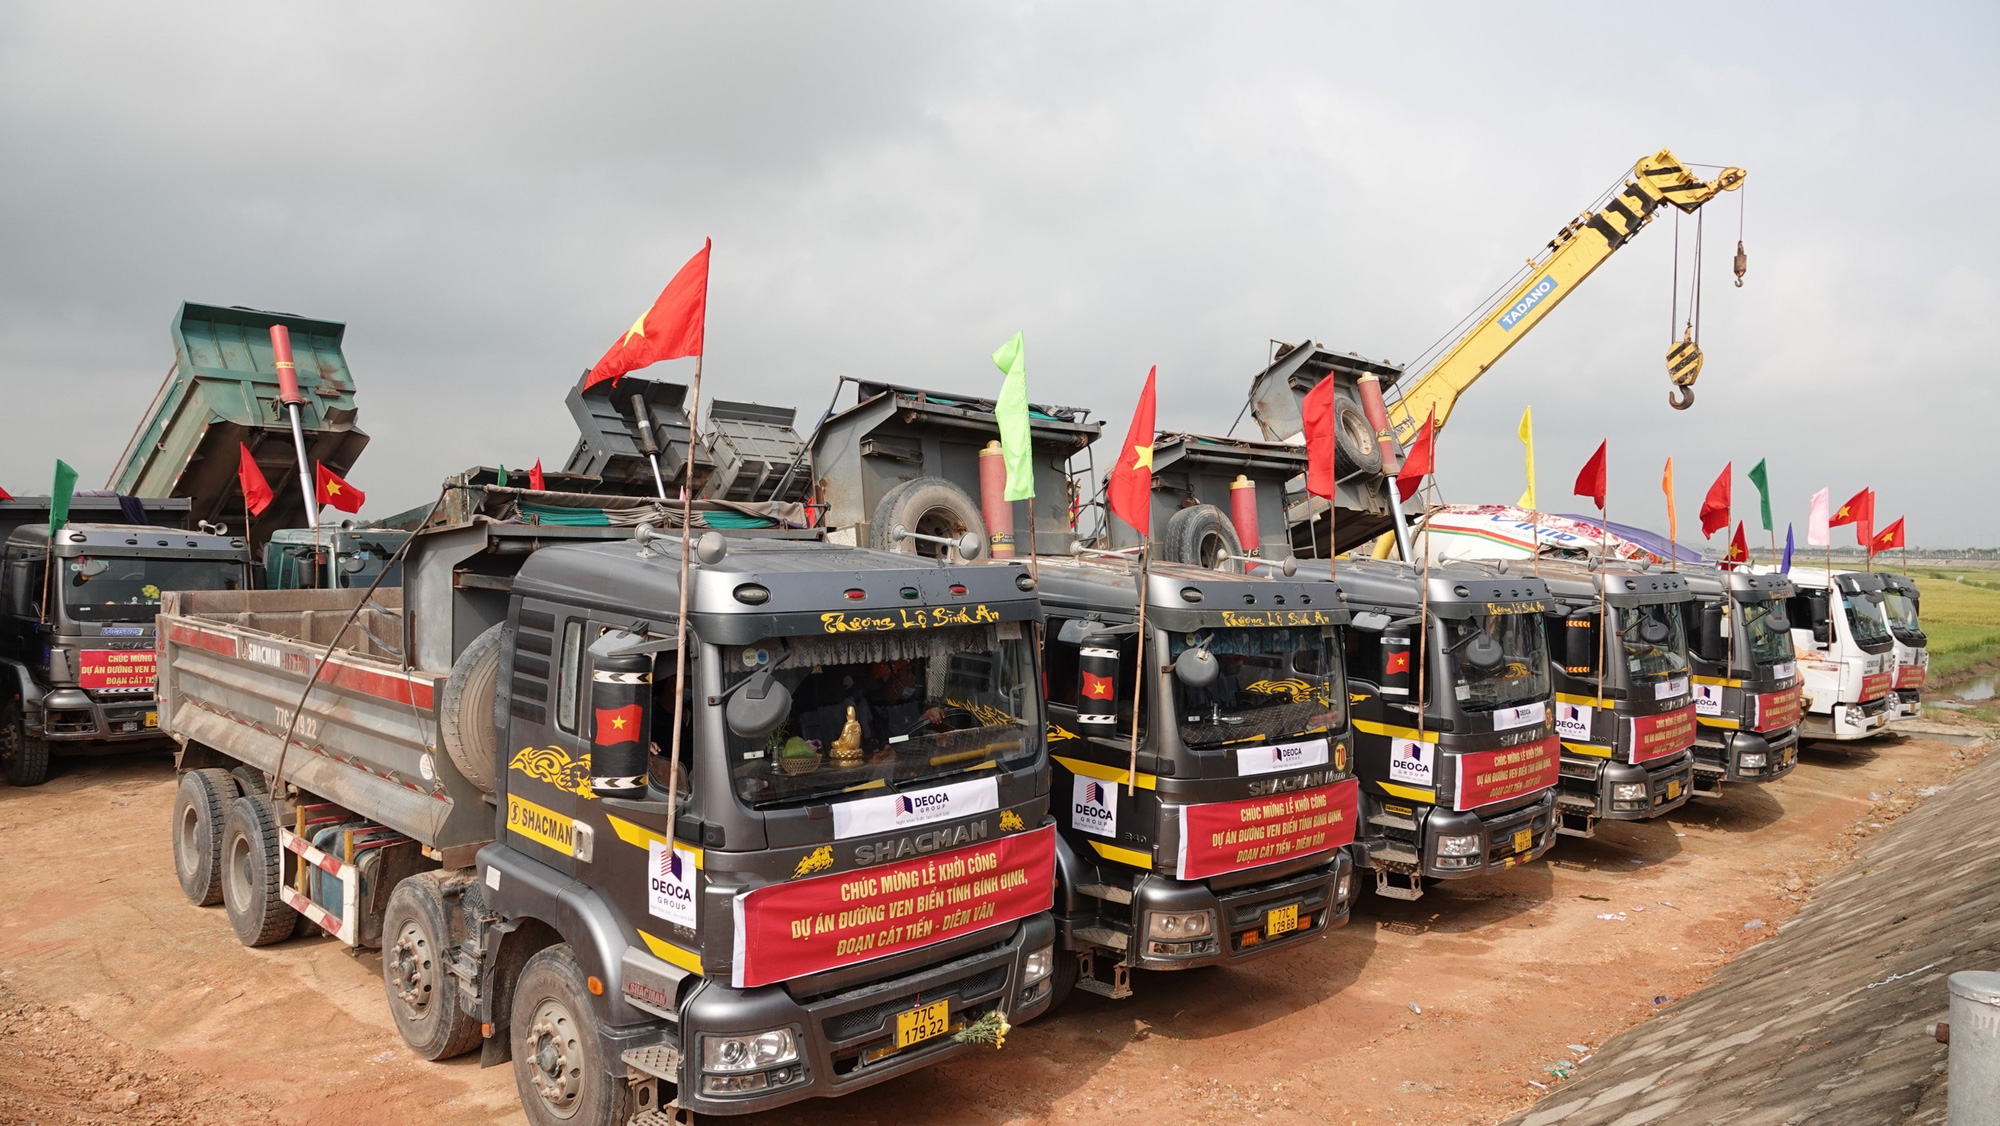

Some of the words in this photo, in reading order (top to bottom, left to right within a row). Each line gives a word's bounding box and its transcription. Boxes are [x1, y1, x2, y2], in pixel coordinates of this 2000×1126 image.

[1503, 282, 1550, 325] TADANO
[900, 609, 927, 628] Lộ
[932, 607, 979, 627] Bình
[975, 605, 999, 622] An
[108, 654, 129, 662] CHÚC
[248, 643, 280, 668] SHACMAN
[94, 664, 105, 674] ÁN
[134, 665, 149, 673] VEN
[128, 675, 143, 684] CÁT
[1283, 747, 1302, 757] DEOCA
[1336, 747, 1346, 767] 70
[1393, 760, 1429, 773] DEOCA
[1249, 771, 1323, 796] SHACMAN
[914, 793, 949, 808] DEOCA
[920, 804, 946, 813] GROUP
[1075, 803, 1113, 821] DEOCA
[1080, 816, 1108, 827] GROUP
[1240, 804, 1261, 822] CHÚC
[1262, 801, 1284, 819] MỪNG
[522, 807, 573, 847] SHACMAN
[1212, 830, 1225, 849] DỰ
[1225, 828, 1237, 845] ÁN
[1239, 825, 1264, 842] ĐƯỜNG
[1266, 823, 1280, 837] VEN
[1282, 816, 1297, 835] BIỂN
[855, 819, 987, 865] SHACMAN
[1259, 841, 1274, 858] CÁT
[1275, 837, 1291, 856] TIẾN
[841, 877, 877, 901] CHÚC
[880, 870, 919, 894] MỪNG
[922, 861, 936, 886] LỄ
[938, 855, 965, 881] KHỞI
[967, 853, 997, 874] CÔNG
[652, 877, 692, 902] DEOCA
[657, 896, 686, 911] GROUP
[791, 916, 812, 940] DỰ
[815, 912, 835, 934] ÁN
[838, 904, 885, 929] ĐƯỜNG
[889, 898, 914, 919] VEN
[917, 886, 944, 913] BIỂN
[1000, 868, 1028, 891] ĐỊNH,
[1278, 907, 1290, 920] 77C
[836, 933, 875, 956] ĐOẠN
[877, 925, 903, 947] CÁT
[906, 916, 933, 940] TIẾN
[942, 909, 971, 931] DIÊM
[973, 902, 995, 922] VÂN
[629, 983, 666, 1006] SHACMAN
[913, 1006, 934, 1025] 77C
[905, 1018, 943, 1043] 179.22
